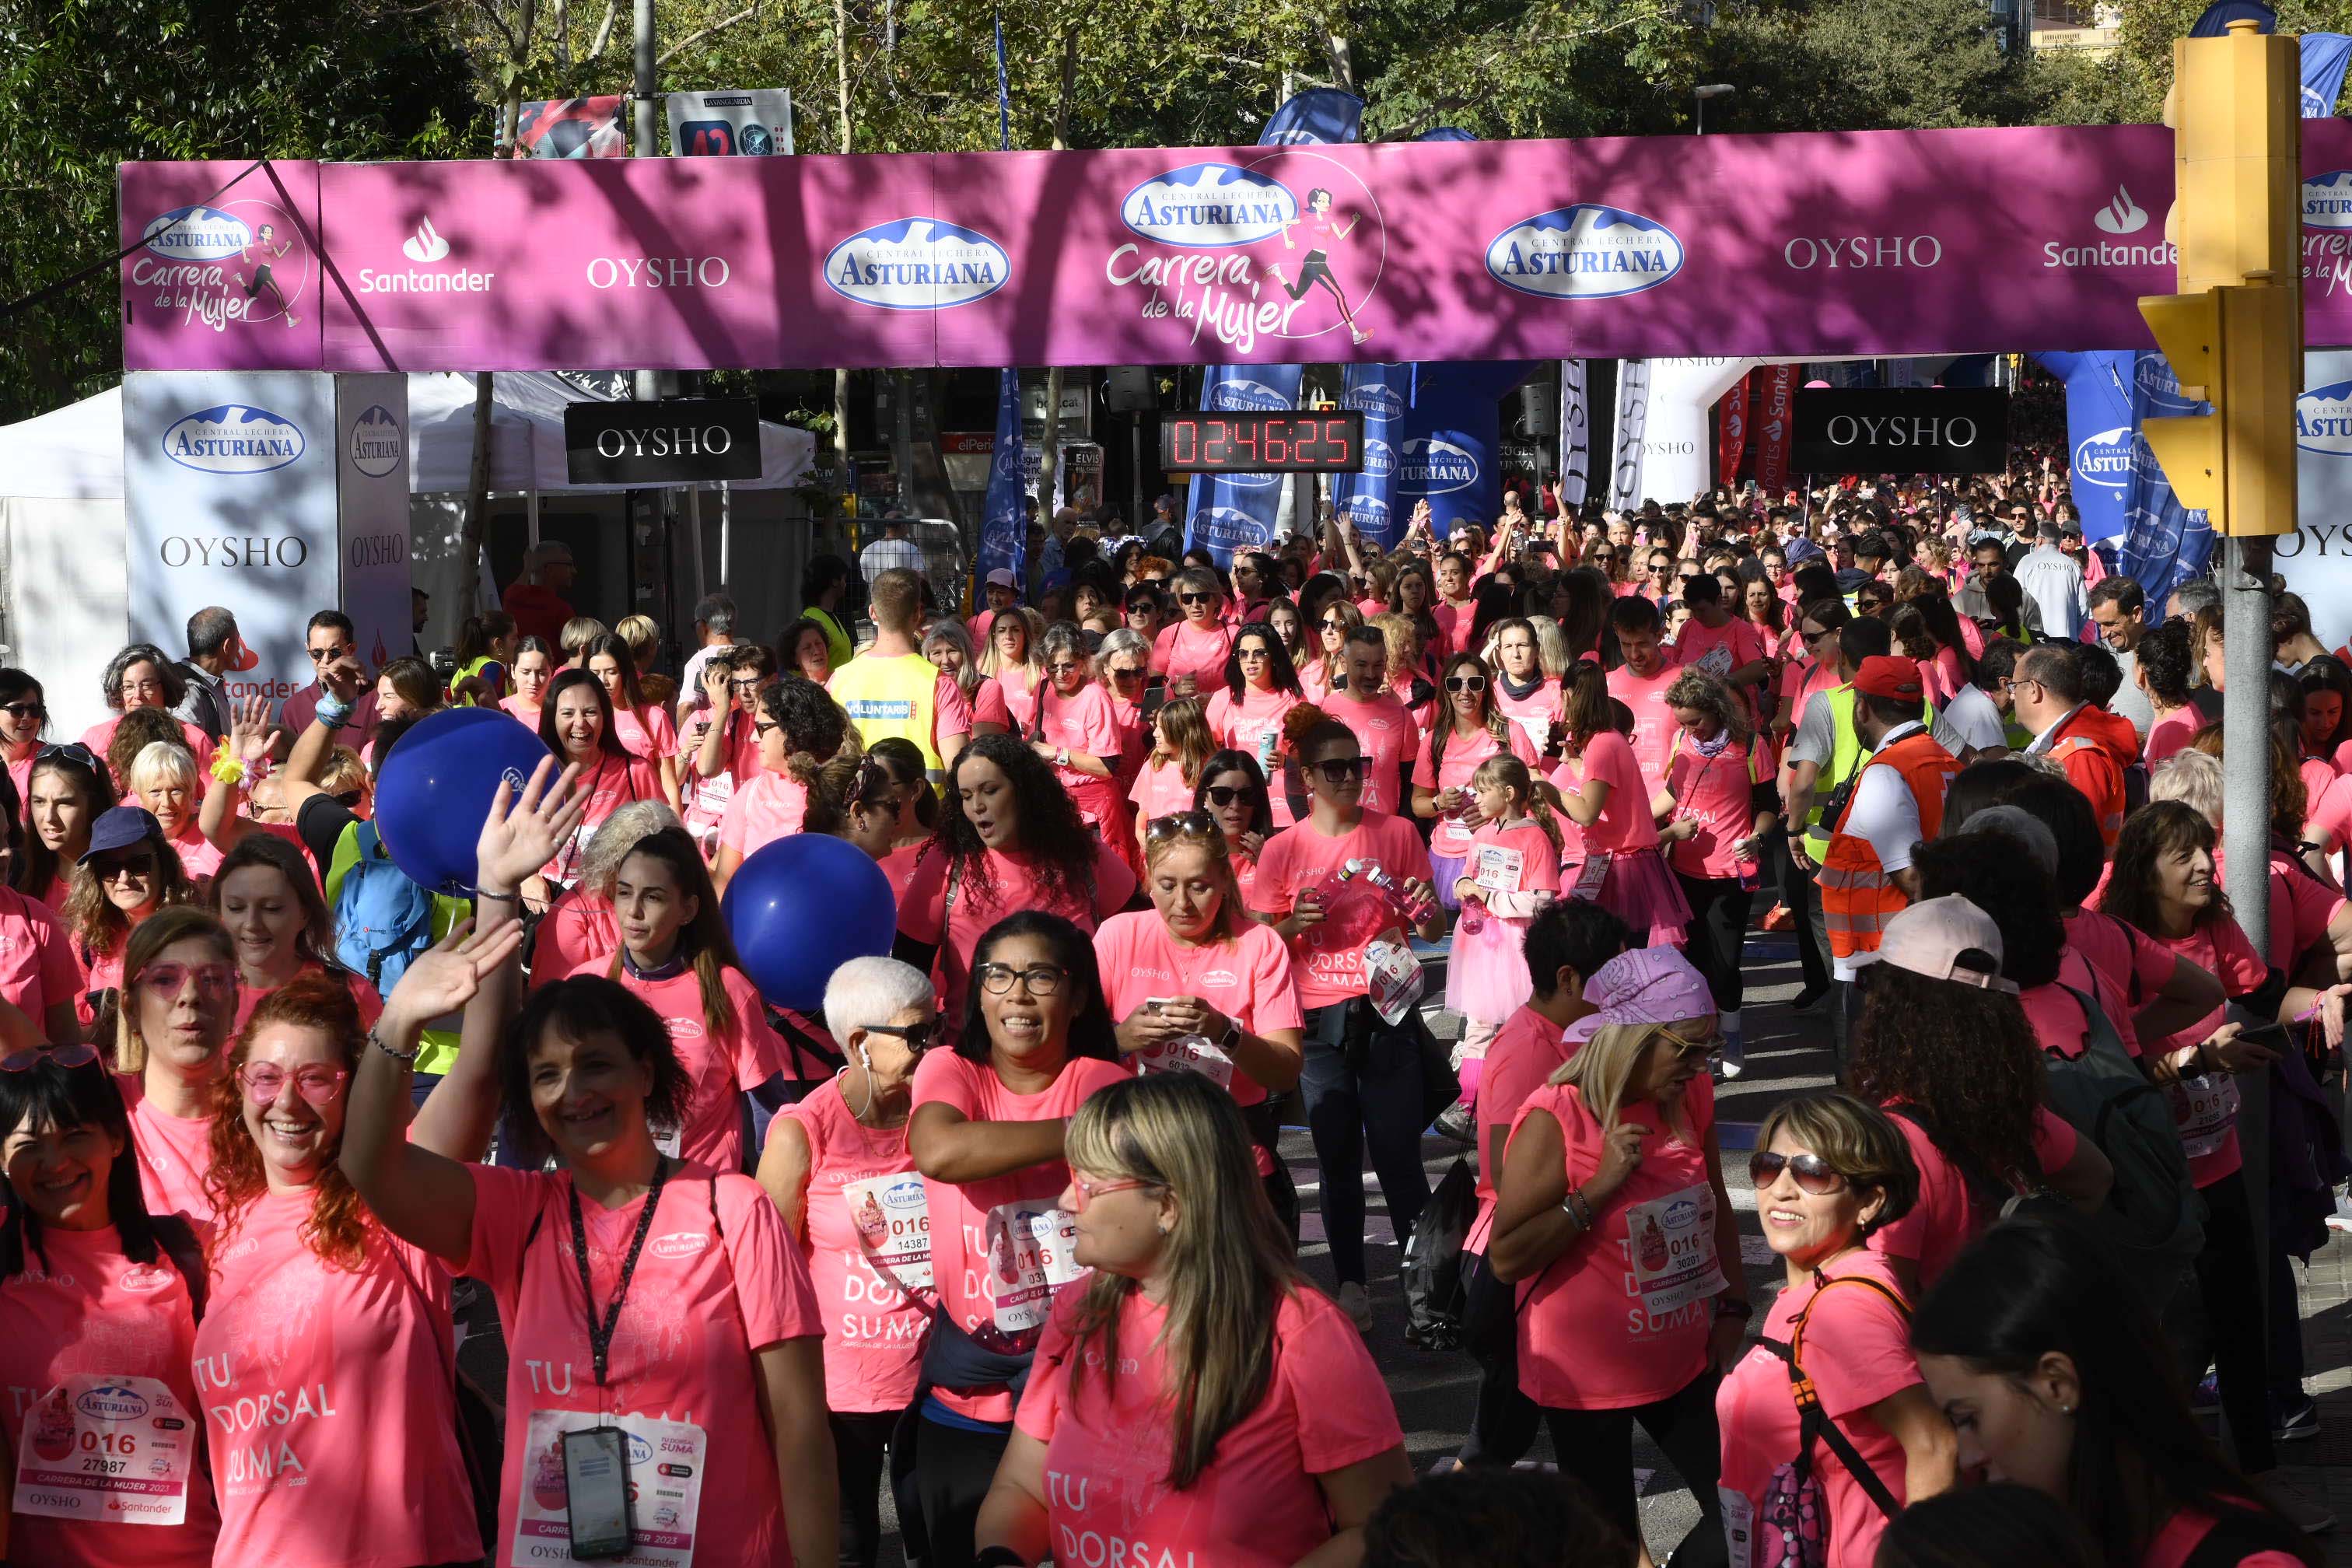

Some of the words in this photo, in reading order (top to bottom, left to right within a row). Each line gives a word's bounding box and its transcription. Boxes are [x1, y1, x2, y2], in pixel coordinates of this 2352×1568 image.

[1162, 191, 1218, 201] CENTRAL
[1223, 191, 1279, 201] LECHERA
[1135, 194, 1283, 226] ASTURIANA
[151, 226, 243, 247] ASTURIANA
[1531, 236, 1593, 248] CENTRAL
[1599, 235, 1662, 247] LECHERA
[866, 249, 923, 259] CENTRAL
[933, 248, 990, 258] LECHERA
[1500, 240, 1670, 276] ASTURIANA
[1784, 235, 1942, 270] OYSHO
[2043, 241, 2178, 268] Santande
[132, 257, 224, 287] Carrera
[586, 257, 730, 289] OYSHO
[838, 252, 996, 286] ASTURIANA
[1106, 243, 1251, 287] Carrera
[2316, 256, 2330, 278] la
[359, 268, 495, 293] Santander
[155, 288, 171, 308] de
[175, 287, 187, 308] la
[185, 284, 259, 332] Mujer
[1142, 289, 1169, 319] de
[1174, 285, 1194, 319] la
[1190, 281, 1306, 354] Mujer
[1769, 364, 1790, 418] Santa
[597, 425, 732, 457] OYSHO
[1174, 419, 1348, 464] 02:46:25
[1827, 415, 1977, 447] OYSHO
[173, 430, 296, 457] ASTURIANA
[354, 436, 400, 460] ASTURIANA
[1076, 453, 1100, 464] ELVIS
[1399, 466, 1471, 481] TURIANA
[1349, 512, 1390, 526] TURIANA
[160, 535, 307, 569] OYSHO
[352, 533, 404, 568] OYSHO
[2038, 560, 2074, 573] OYSHO
[223, 678, 299, 699] tander
[845, 702, 908, 715] VOLUNTARIS
[1641, 761, 1659, 772] 2019
[1361, 779, 1380, 788] SAL
[1480, 867, 1499, 878] 016
[1131, 967, 1171, 981] OYSHO
[1166, 1042, 1199, 1061] 016
[887, 1192, 927, 1205] ASTURIAN
[892, 1216, 929, 1236] 016
[898, 1237, 928, 1251] 14387
[1671, 1232, 1699, 1256] 016
[1017, 1248, 1053, 1270] 016
[1676, 1255, 1700, 1271] 30201
[1651, 1290, 1684, 1307] OYSHO
[842, 1313, 932, 1340] SUMA
[1628, 1299, 1705, 1335] SUMA
[194, 1353, 231, 1392] TU
[525, 1359, 572, 1396] TU
[82, 1396, 144, 1416] ASTURIANA
[210, 1384, 336, 1434] DORSAL
[80, 1431, 136, 1454] 016
[660, 1443, 695, 1454] SUMA
[82, 1458, 127, 1474] 27987
[227, 1439, 305, 1484] SUMA
[37, 1474, 82, 1486] CARRERA
[84, 1478, 98, 1487] DE
[99, 1479, 112, 1489] LA
[114, 1481, 146, 1491] MUJER
[149, 1484, 170, 1493] 2023
[1047, 1469, 1089, 1513] TU
[30, 1493, 81, 1509] OYSHO
[121, 1502, 172, 1514] Santander
[538, 1525, 570, 1535] CARRE
[654, 1535, 678, 1545] 2023
[530, 1545, 571, 1560] OYSH
